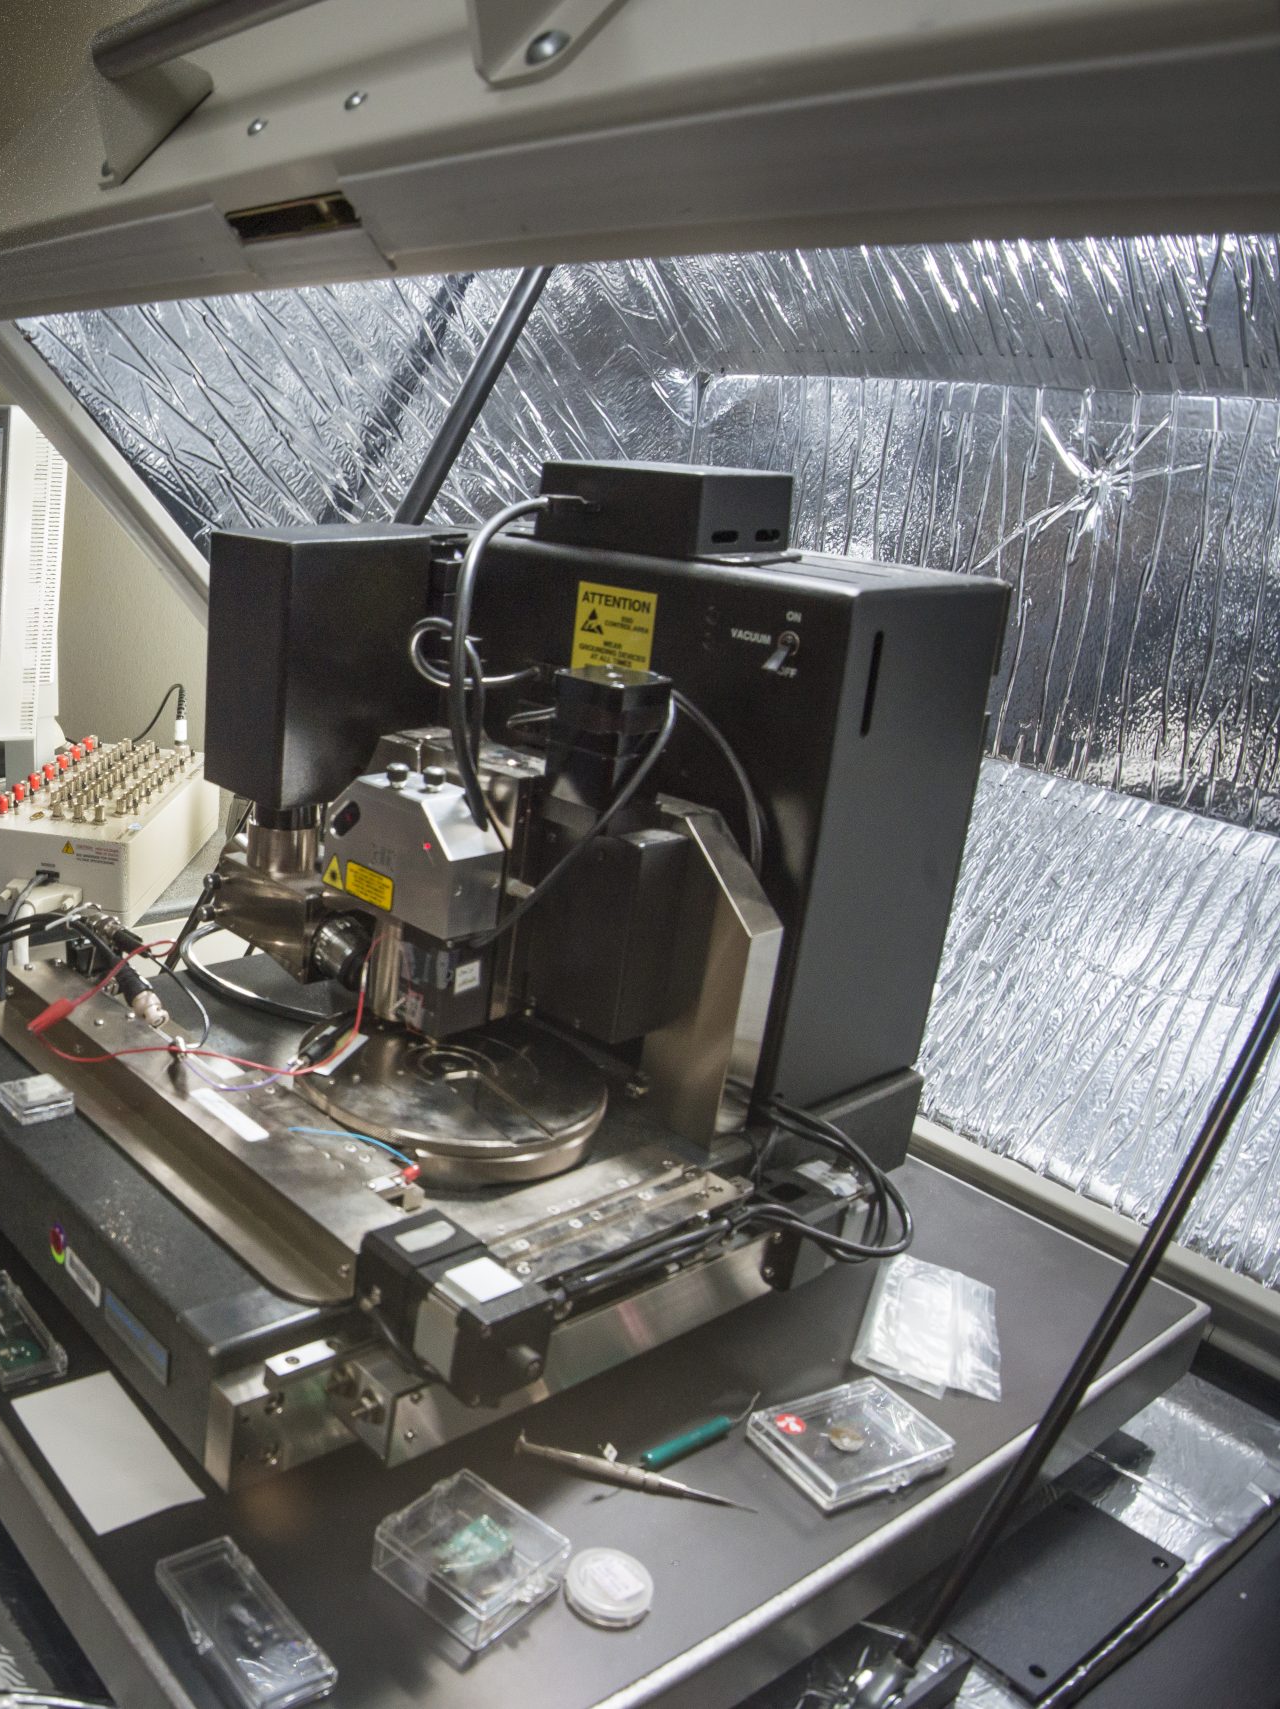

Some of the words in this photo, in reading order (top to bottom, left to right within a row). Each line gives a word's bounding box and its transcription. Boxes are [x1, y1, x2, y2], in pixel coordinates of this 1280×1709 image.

[582, 591, 651, 614] ATTENTION
[785, 611, 802, 623] ON
[730, 627, 772, 645] VACUUM
